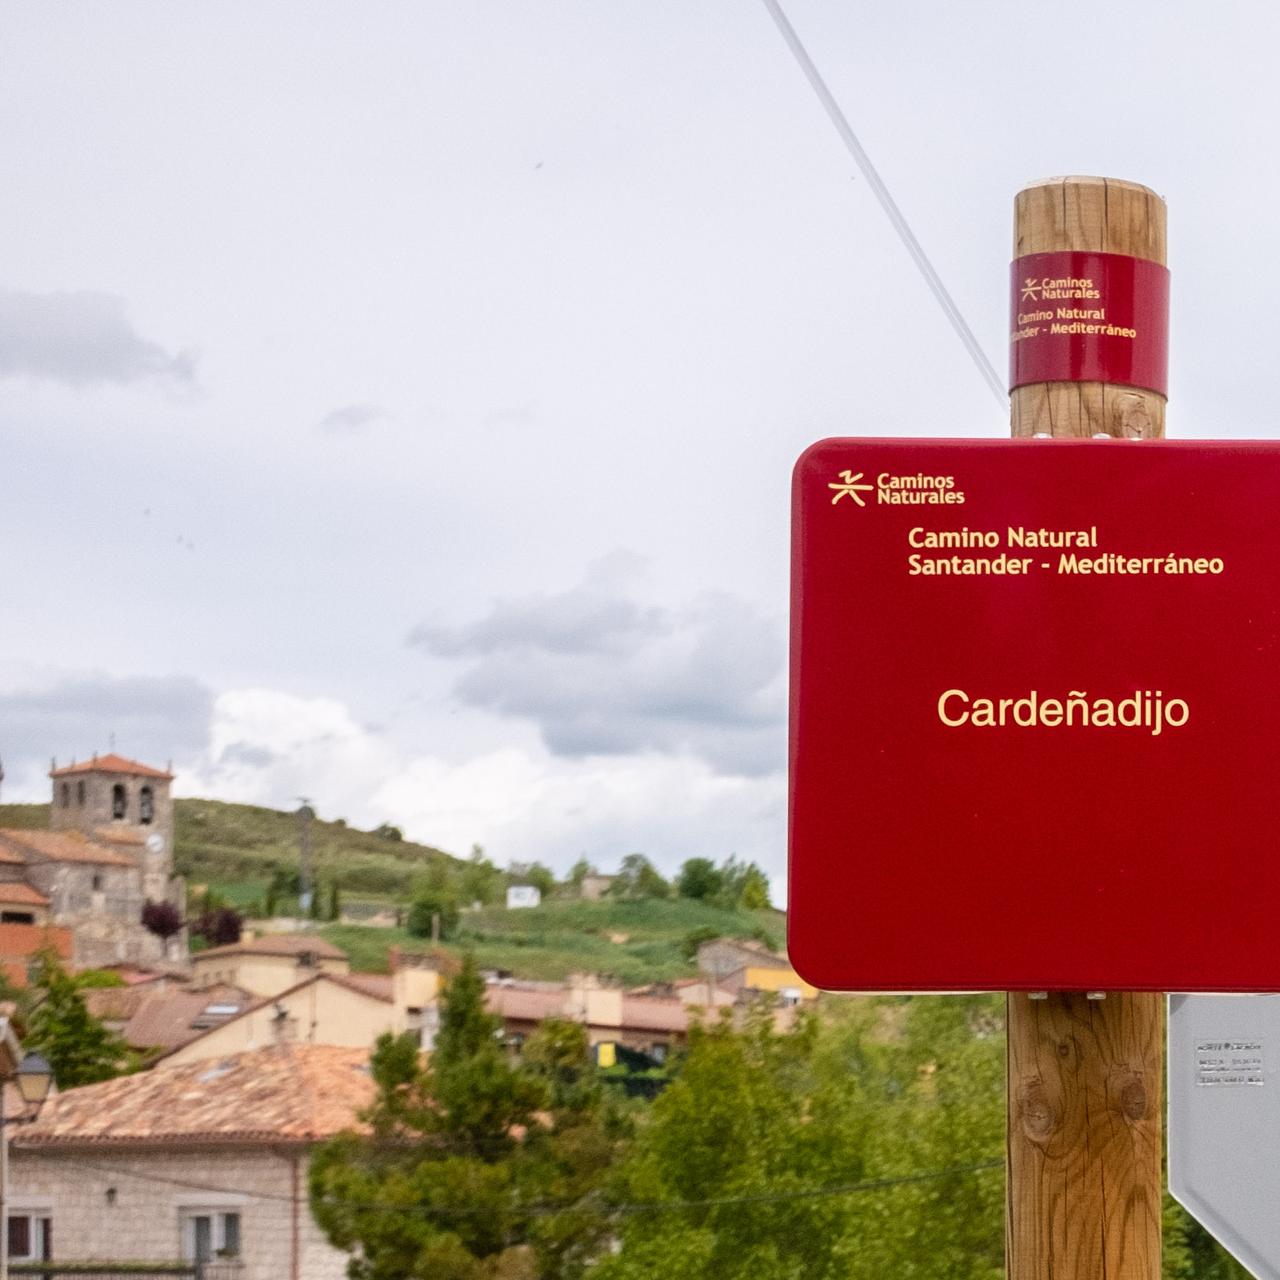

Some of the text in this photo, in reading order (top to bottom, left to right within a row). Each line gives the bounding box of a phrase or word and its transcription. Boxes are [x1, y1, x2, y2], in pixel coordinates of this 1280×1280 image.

[1042, 277, 1093, 289] Caminos
[1042, 287, 1100, 299] Naturales
[1018, 307, 1105, 325] Camino Natural
[1050, 321, 1137, 338] Mediterráneo
[877, 472, 955, 489] Caminos
[877, 487, 965, 504] Naturales
[908, 527, 1097, 548] Camino Natural
[908, 553, 1033, 575] Santander
[1057, 553, 1224, 575] Mediterráneo
[938, 688, 1190, 735] Cardeñadijo
